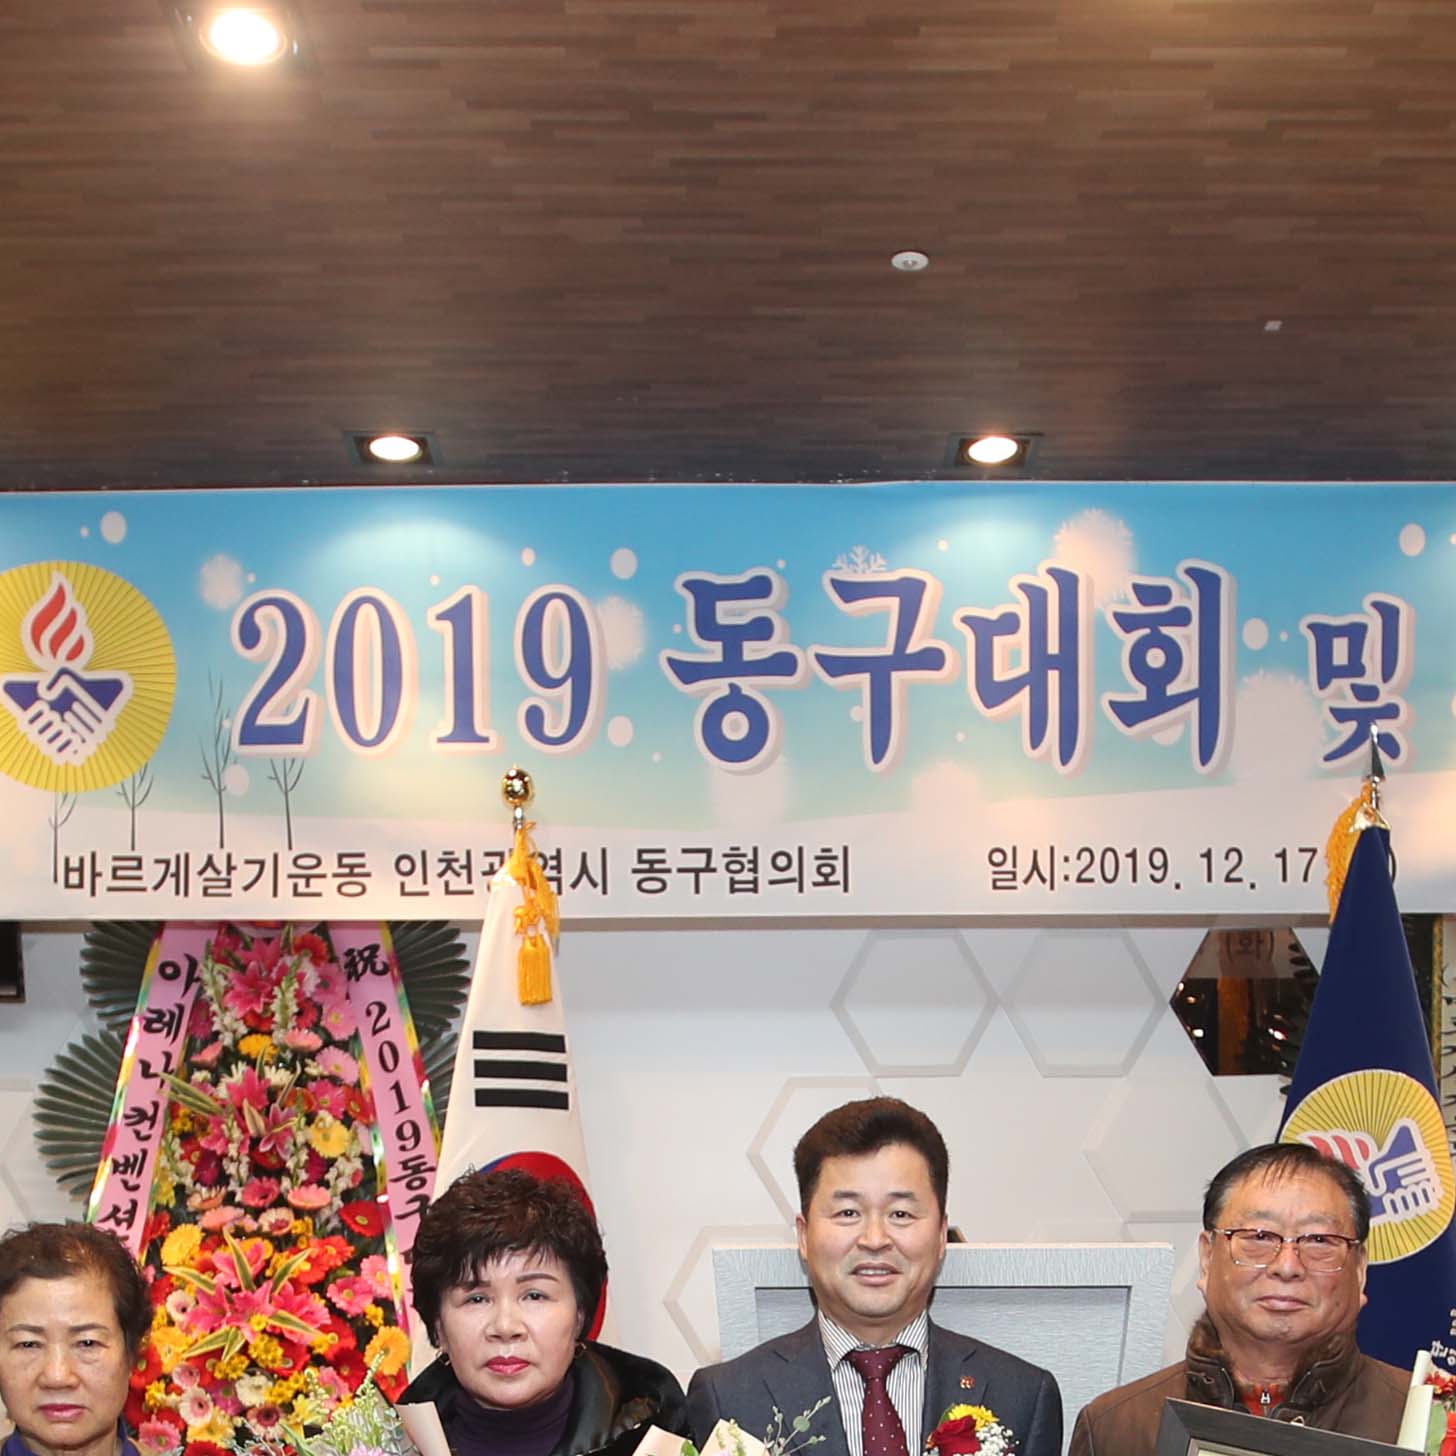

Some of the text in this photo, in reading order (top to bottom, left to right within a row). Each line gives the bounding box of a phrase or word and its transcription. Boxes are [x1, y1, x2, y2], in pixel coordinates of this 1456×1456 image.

[235, 588, 597, 752] 2019
[662, 563, 1226, 772] 동구대회
[1304, 598, 1404, 764] 및
[62, 850, 373, 898] 바르게살기운동
[630, 845, 851, 894] 동구협의회
[987, 845, 1182, 890] 일시:2019.
[1198, 846, 1257, 890] 12.
[343, 943, 390, 982] 祝
